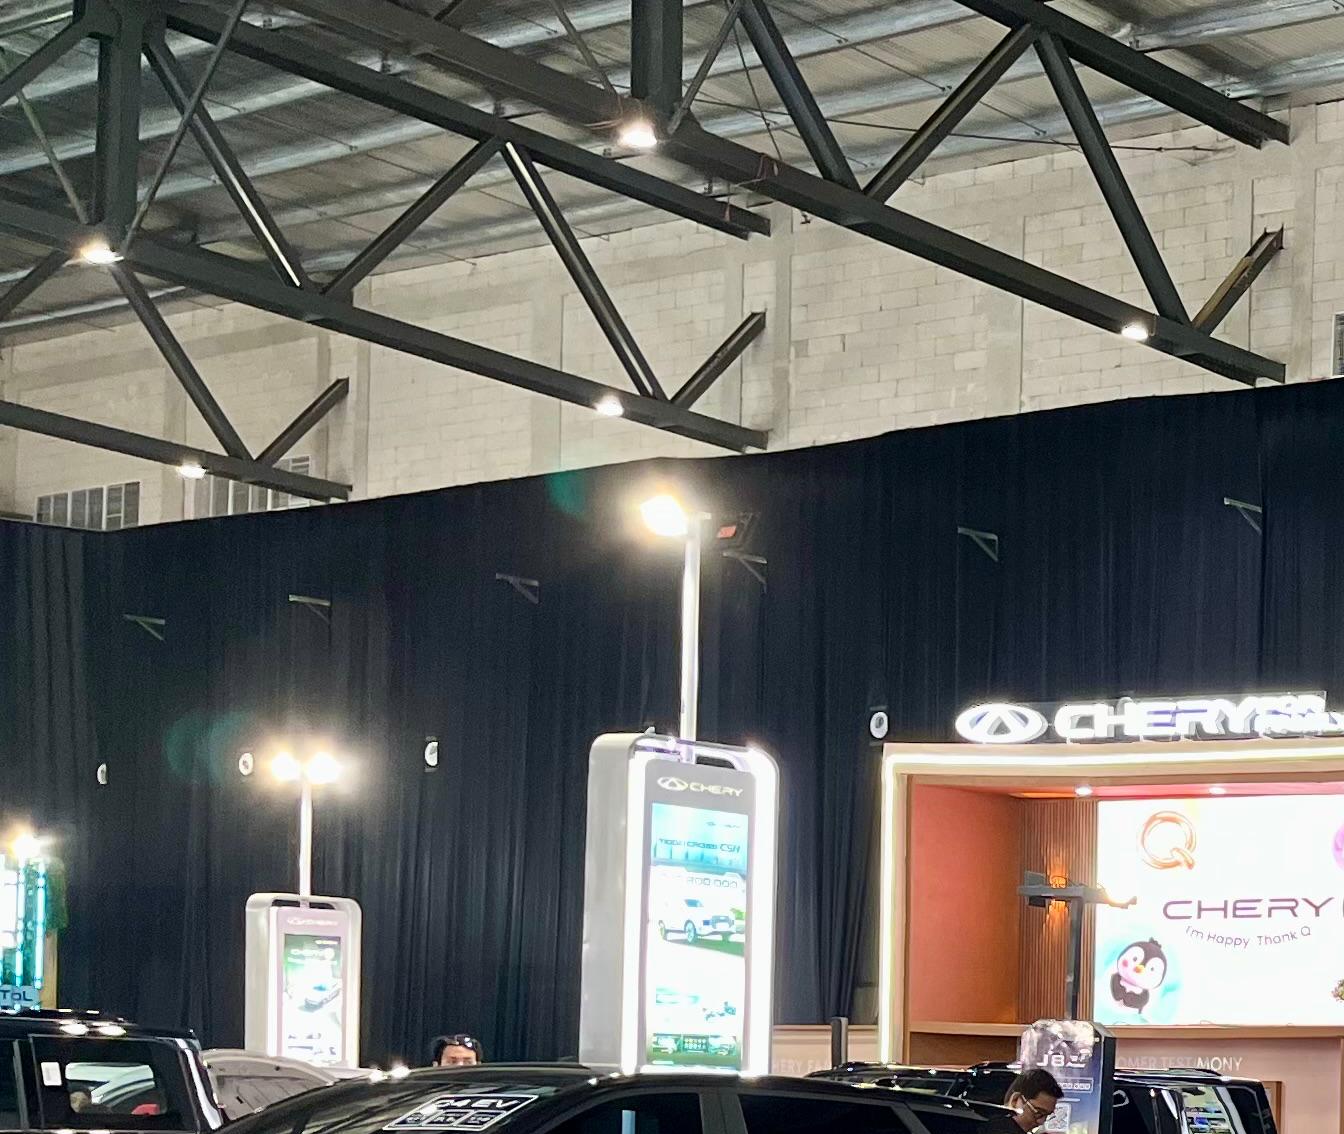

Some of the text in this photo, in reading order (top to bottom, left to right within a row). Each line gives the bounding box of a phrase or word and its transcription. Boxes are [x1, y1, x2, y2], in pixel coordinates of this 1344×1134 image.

[1054, 701, 1258, 738] CHERY
[1163, 897, 1335, 920] CHERY
[1185, 925, 1311, 949] I'm Happy Thank Q
